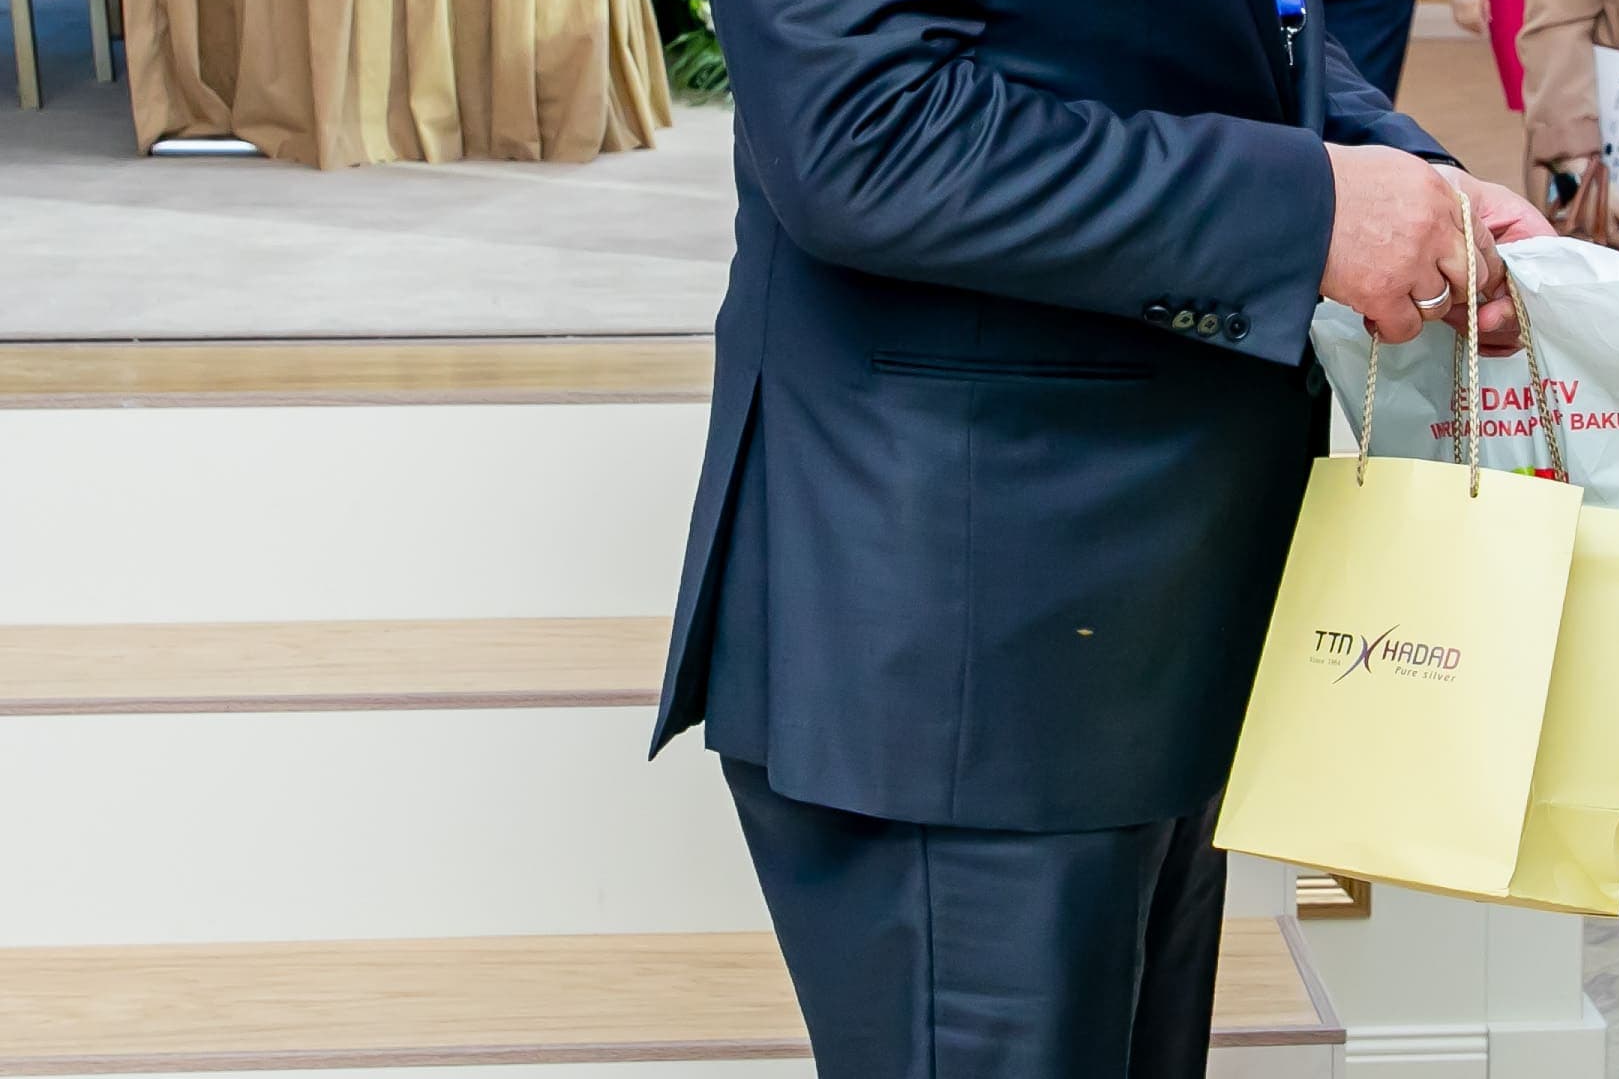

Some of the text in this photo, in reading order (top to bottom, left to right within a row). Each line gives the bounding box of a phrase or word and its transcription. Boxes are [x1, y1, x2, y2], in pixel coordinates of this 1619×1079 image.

[1382, 639, 1462, 670] HADAD
[1395, 665, 1456, 683] Pure silver
